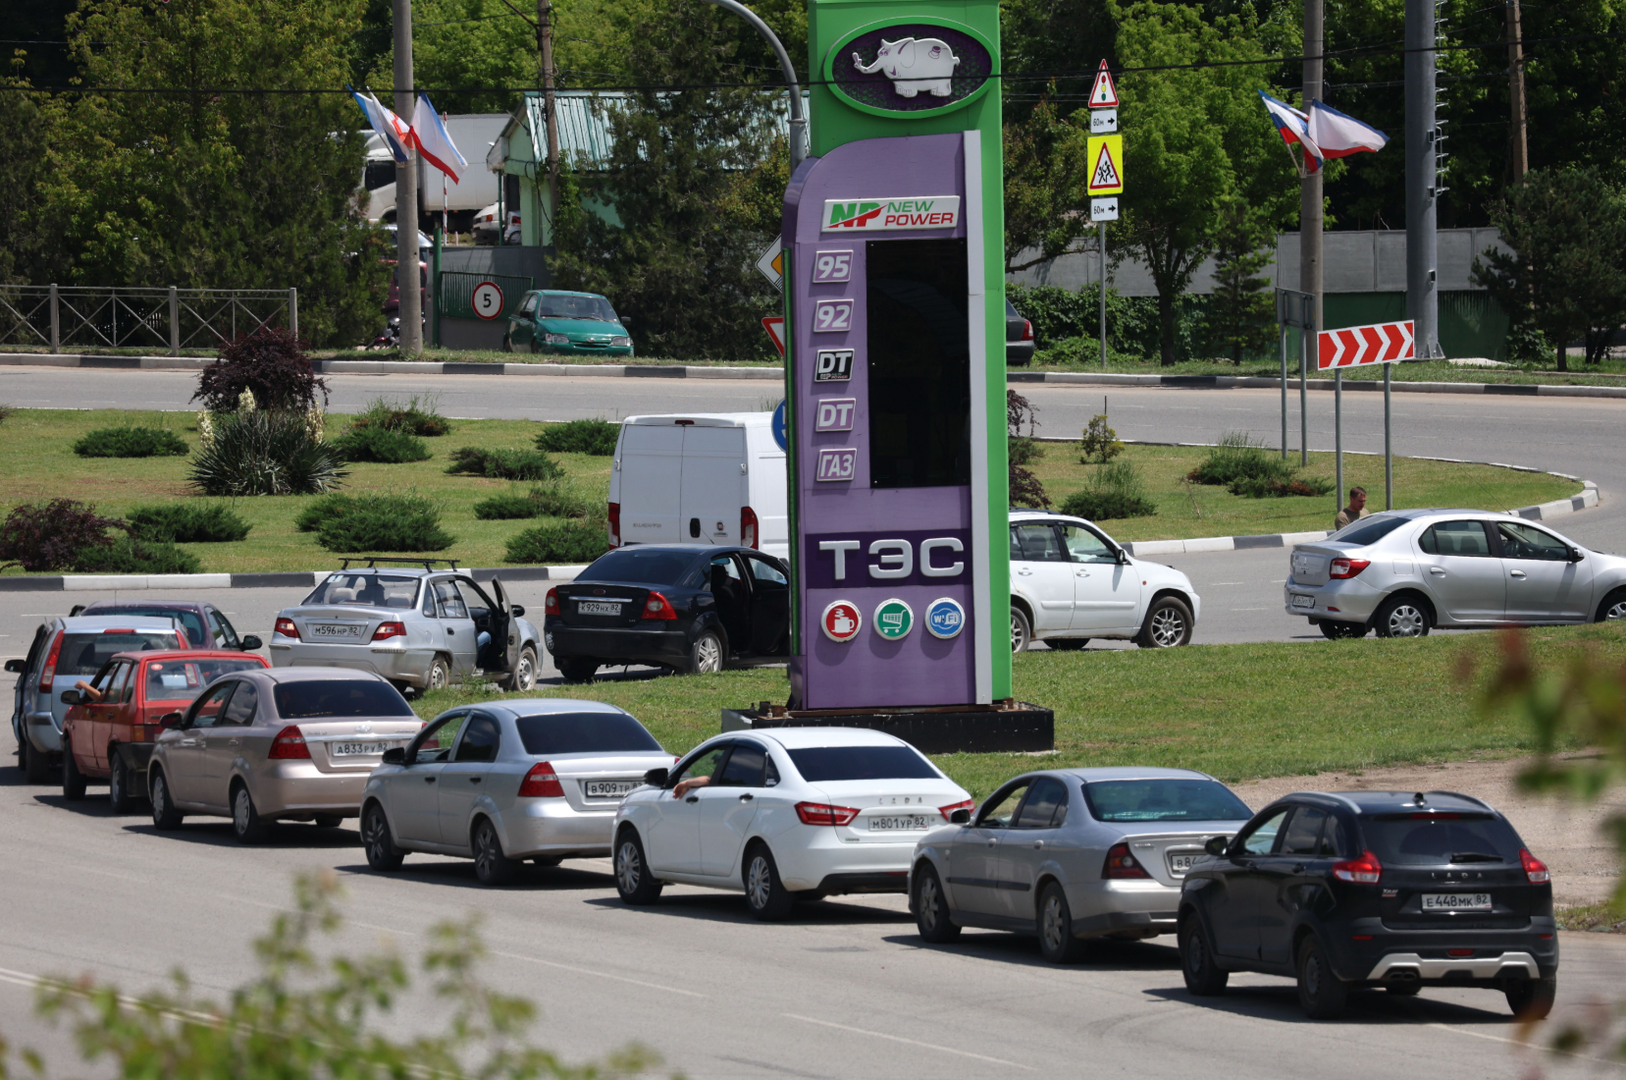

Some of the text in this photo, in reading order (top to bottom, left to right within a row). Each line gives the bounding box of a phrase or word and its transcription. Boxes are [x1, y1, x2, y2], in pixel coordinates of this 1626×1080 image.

[824, 202, 888, 229] NP
[887, 200, 935, 214] NEW
[885, 212, 954, 227] POWER
[818, 255, 850, 279] 95
[483, 293, 492, 308] 5
[818, 304, 851, 328] 92
[818, 352, 852, 374] DT
[818, 403, 853, 427] DT
[820, 453, 853, 477] ГАЗ
[819, 537, 964, 581] ТЭС
[914, 816, 925, 826] 82
[1475, 894, 1488, 904] 82
